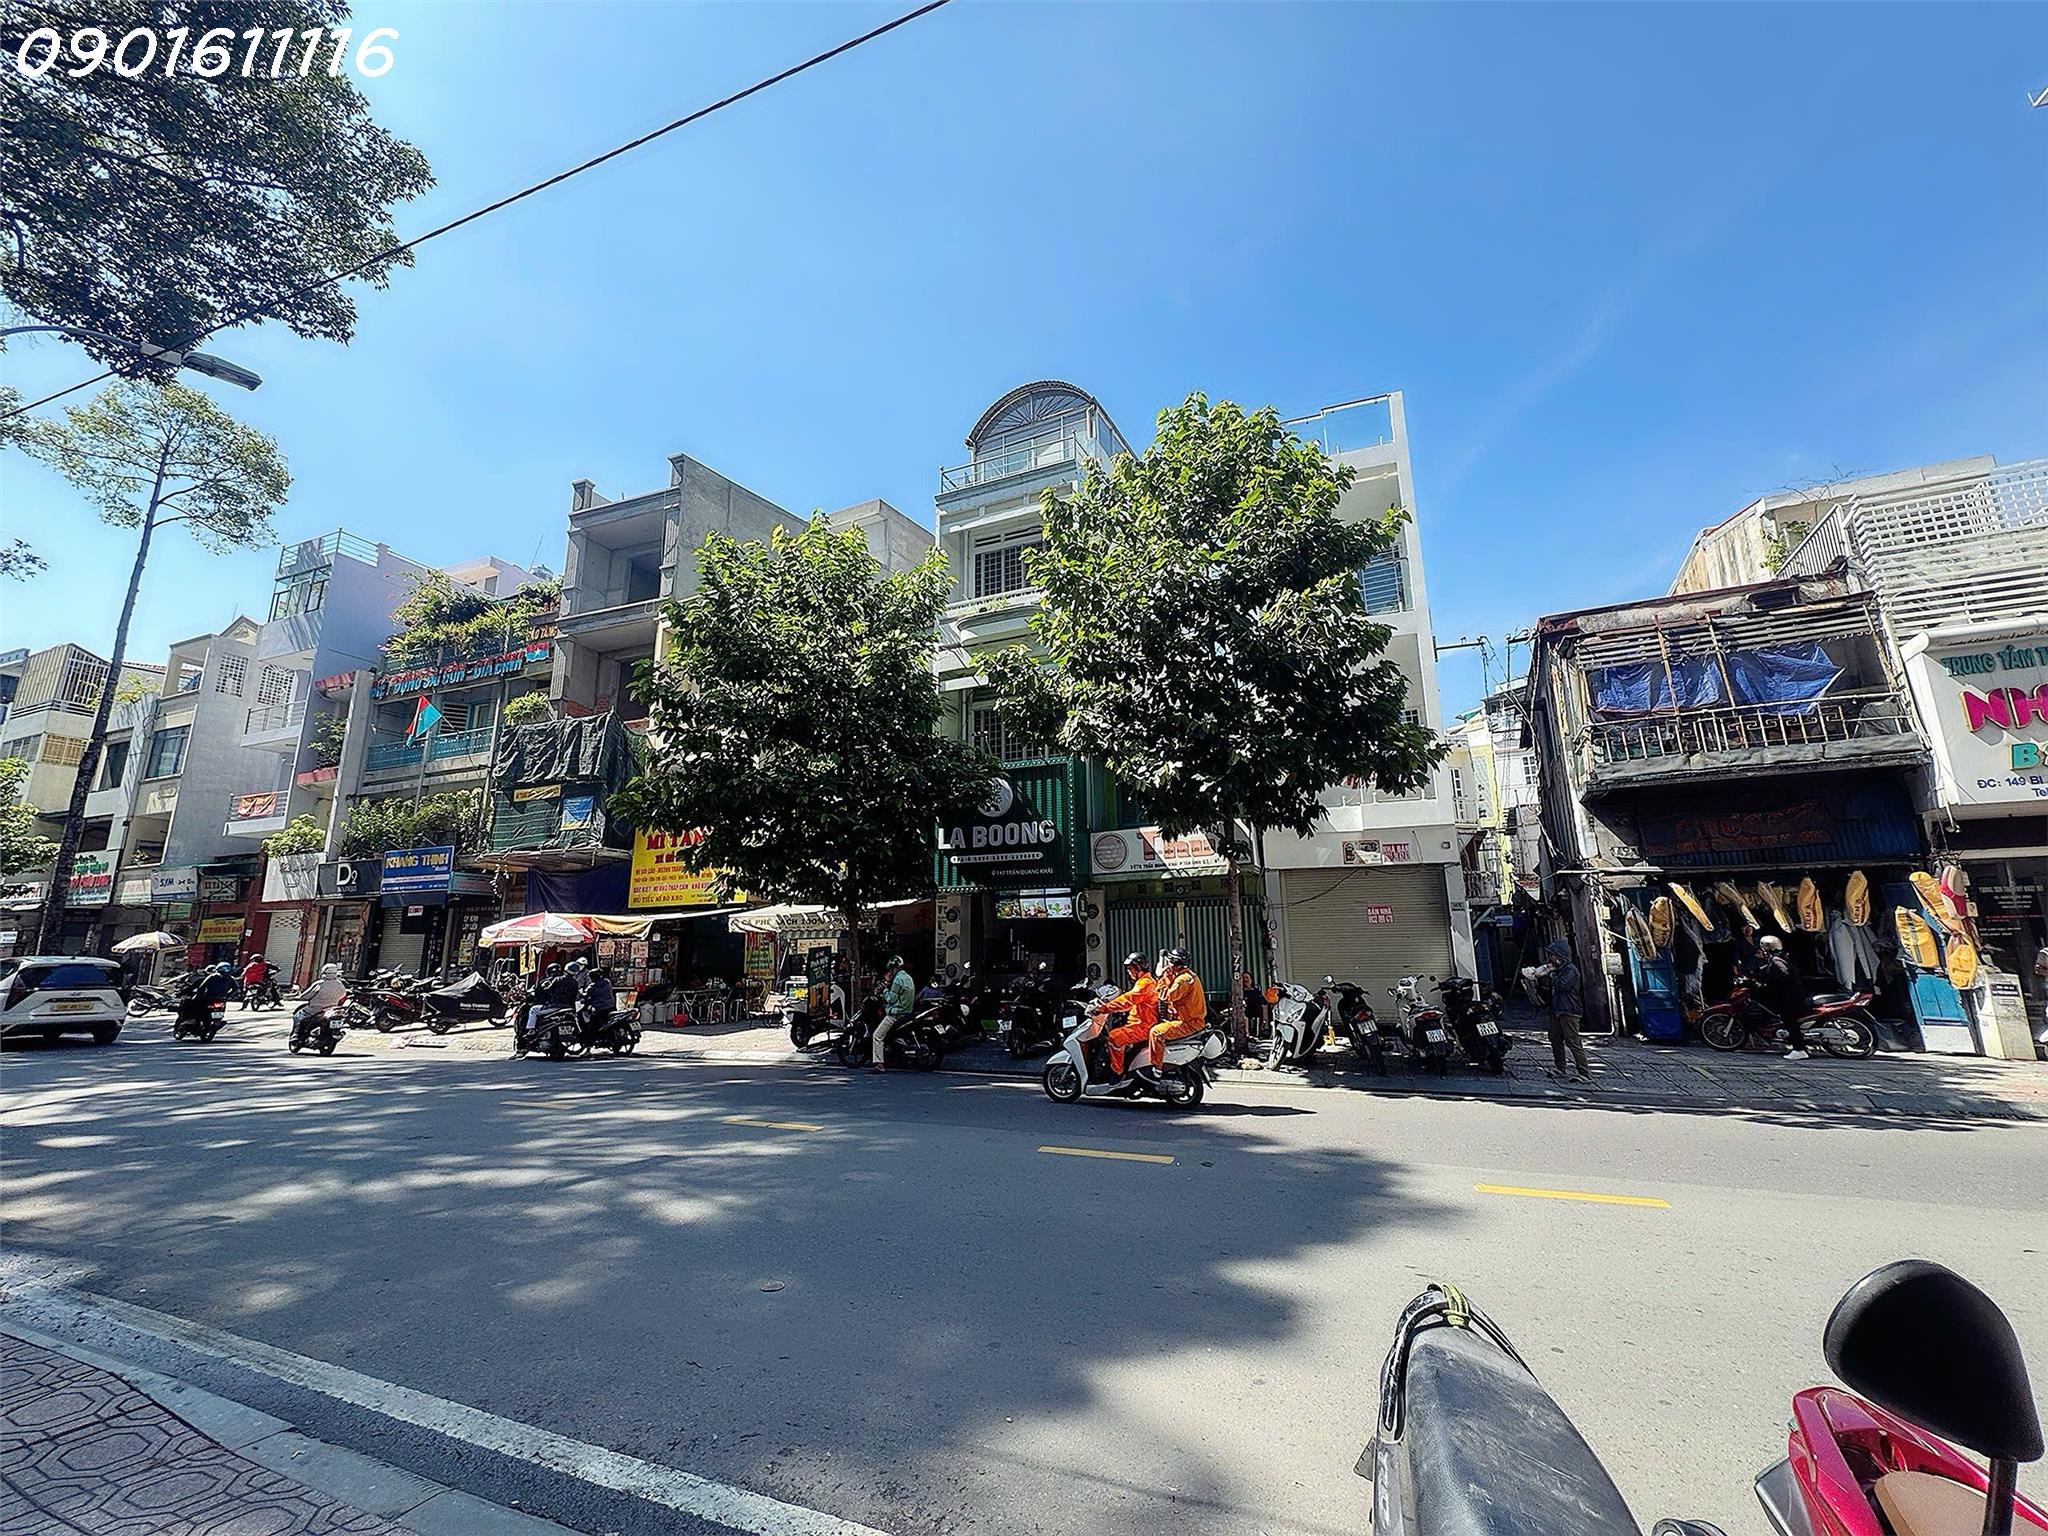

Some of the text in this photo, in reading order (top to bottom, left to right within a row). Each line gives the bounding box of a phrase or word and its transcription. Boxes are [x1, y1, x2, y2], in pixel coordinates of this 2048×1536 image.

[1941, 651, 1996, 677] TRUNG
[1997, 645, 2036, 670] TÂM
[2005, 776, 2026, 787] 149
[938, 819, 1055, 850] LA BOONG
